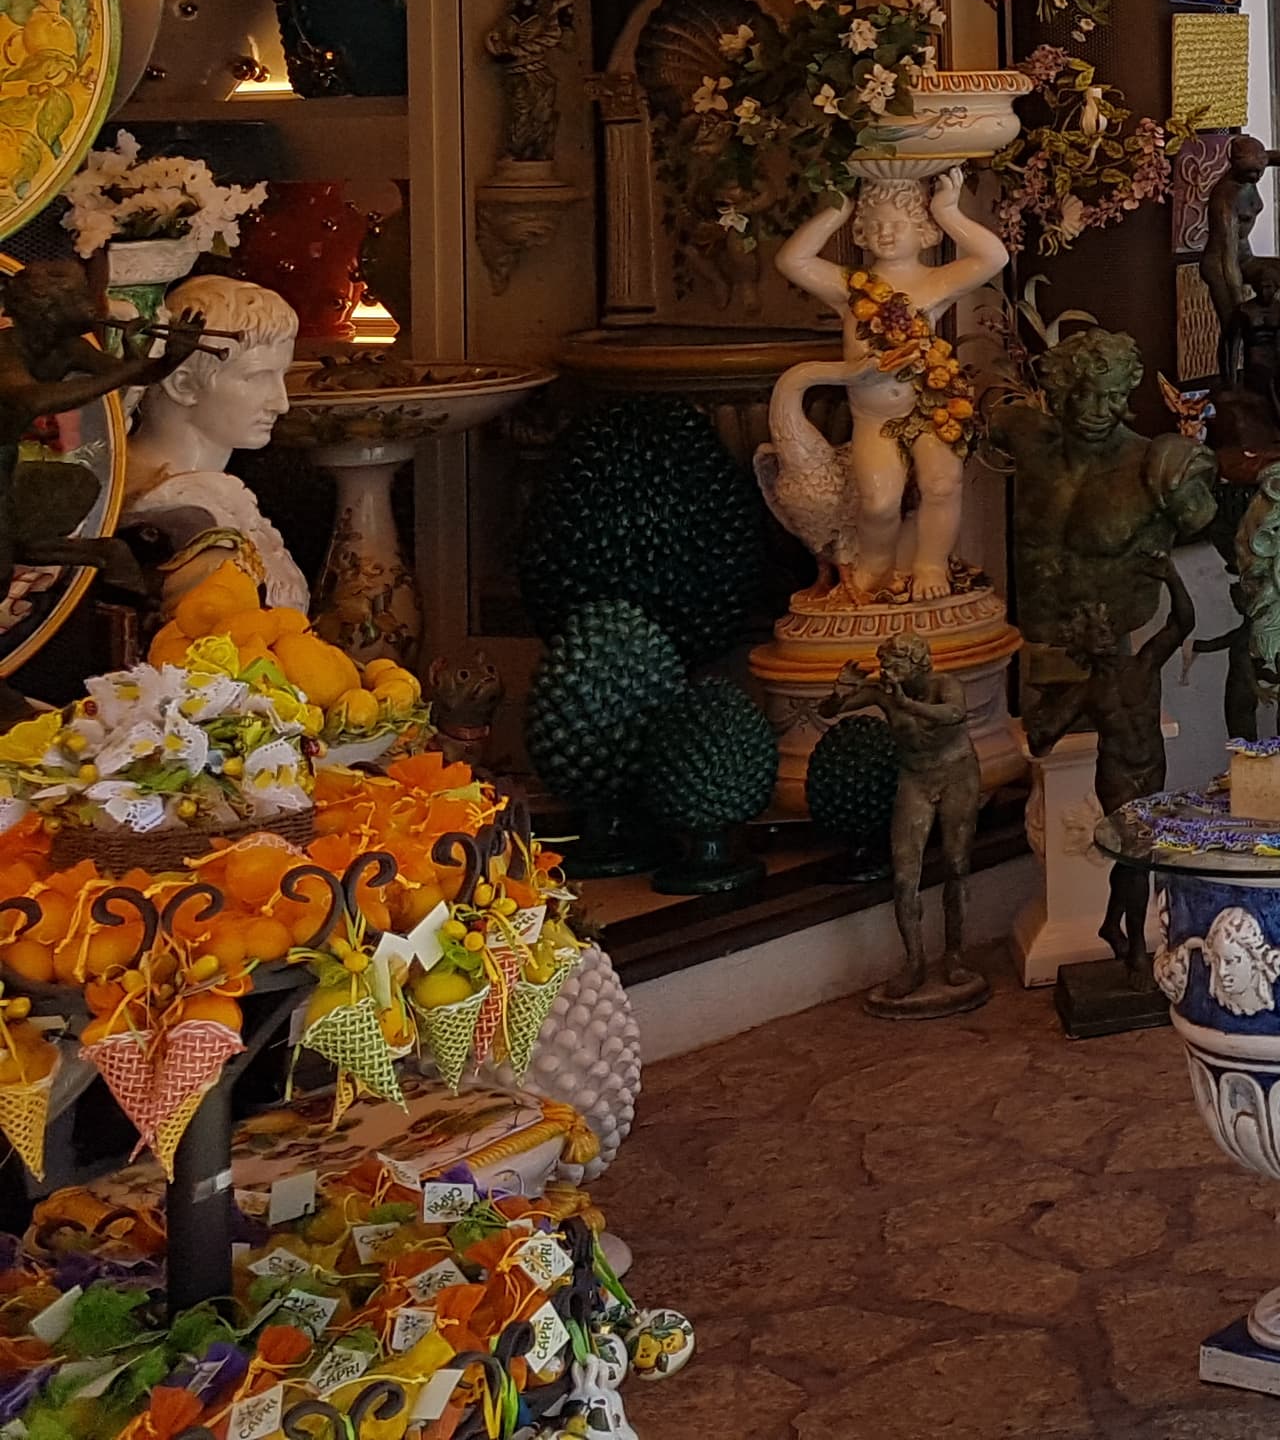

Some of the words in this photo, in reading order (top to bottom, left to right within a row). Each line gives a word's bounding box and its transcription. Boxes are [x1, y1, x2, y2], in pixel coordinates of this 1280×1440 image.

[536, 1316, 555, 1361] CAPRI
[316, 1362, 361, 1391] CAPRI
[238, 1398, 279, 1440] CAPRI
